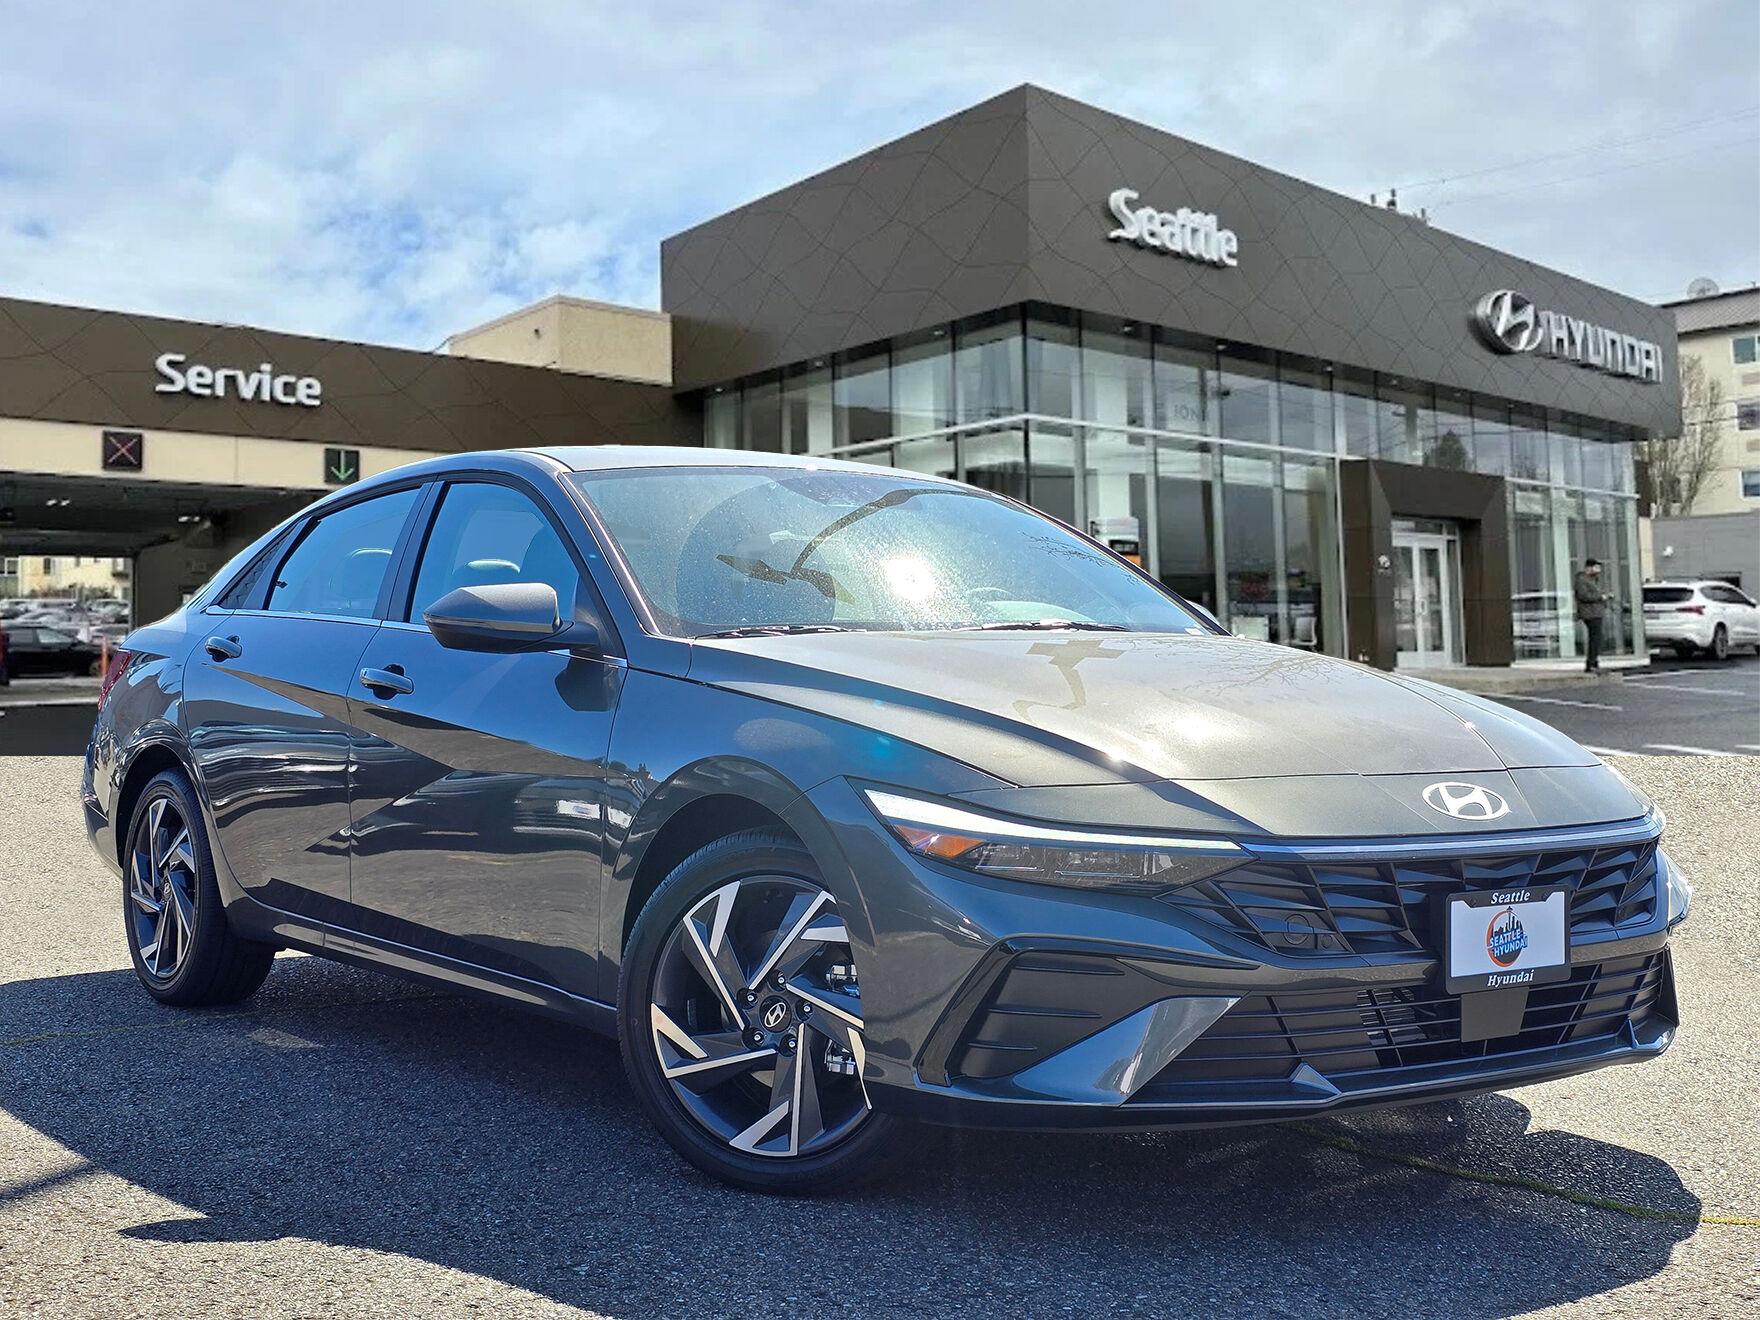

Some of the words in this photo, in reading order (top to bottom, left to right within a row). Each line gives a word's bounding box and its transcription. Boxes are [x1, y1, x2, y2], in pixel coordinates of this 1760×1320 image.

[1109, 188, 1238, 267] Seattle
[1541, 311, 1663, 384] HYUNDAI
[155, 352, 322, 407] Service
[1491, 890, 1530, 904] Seattle
[1490, 928, 1521, 948] SEATTLE
[1487, 969, 1534, 987] Hyundai
